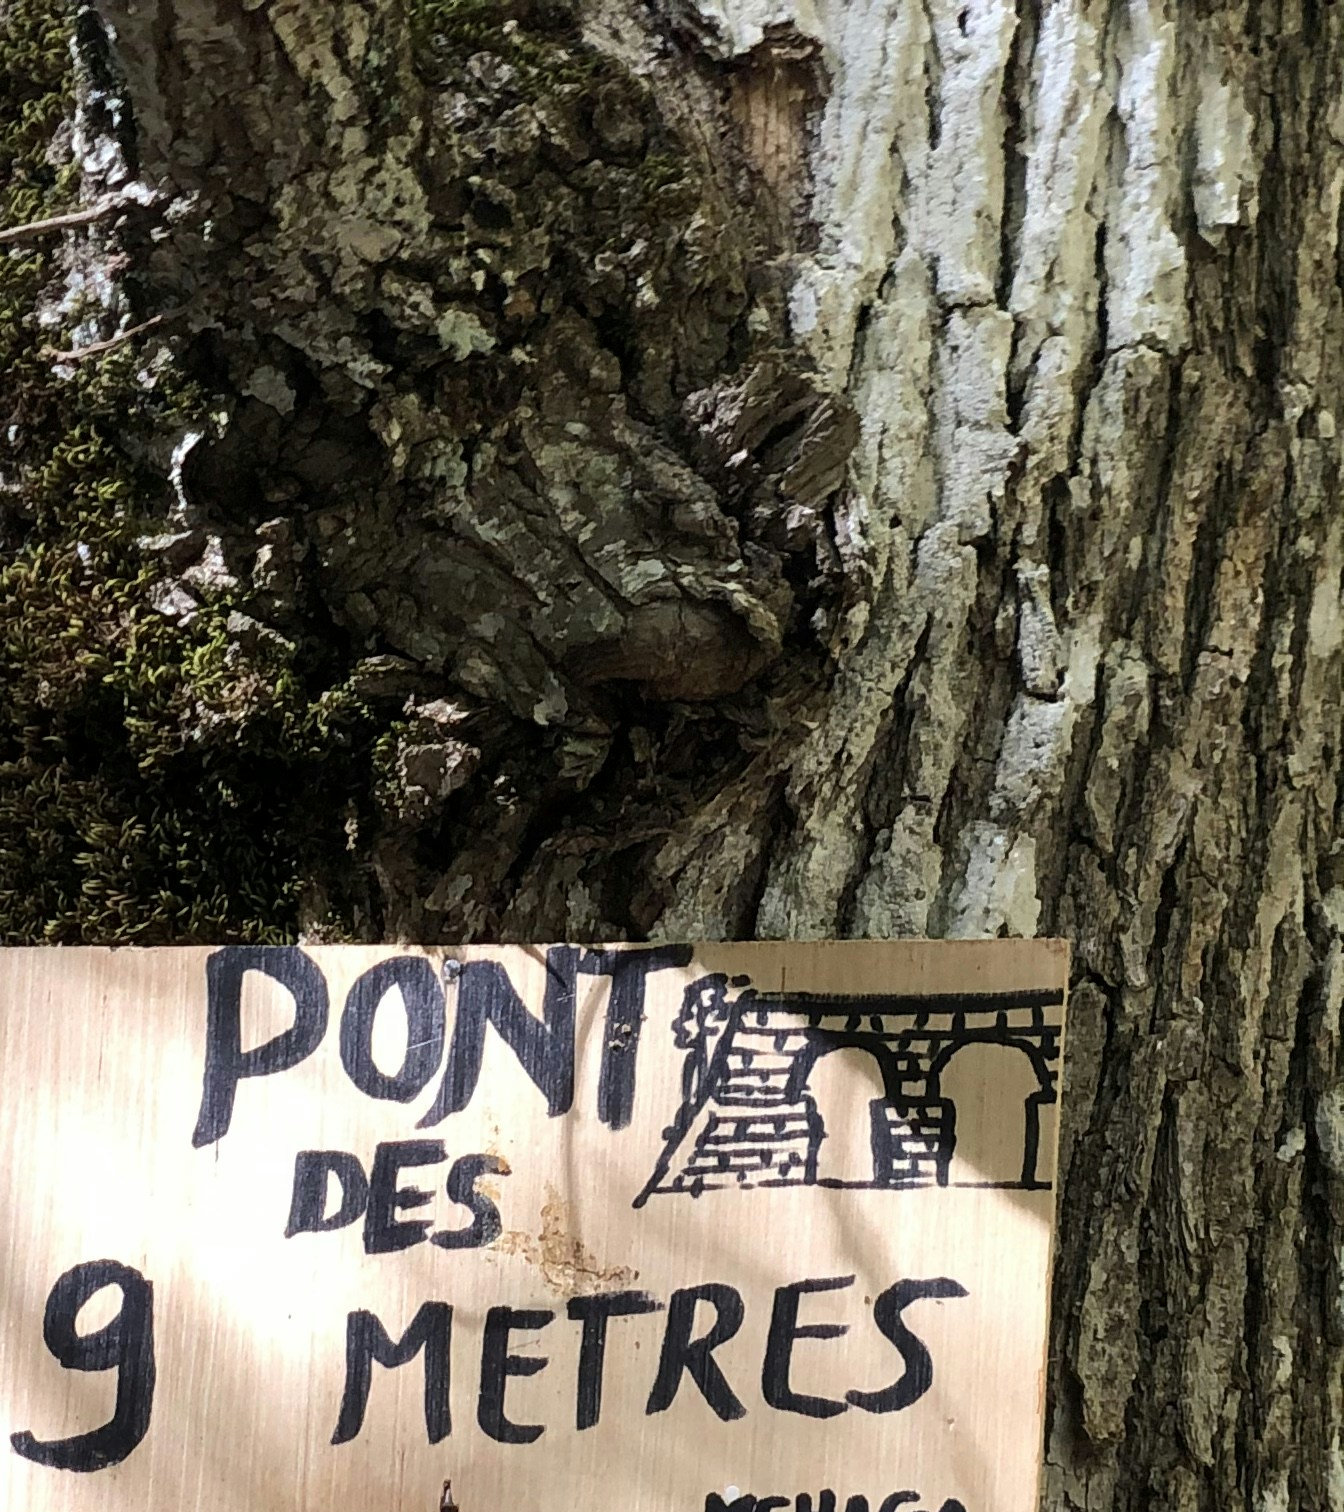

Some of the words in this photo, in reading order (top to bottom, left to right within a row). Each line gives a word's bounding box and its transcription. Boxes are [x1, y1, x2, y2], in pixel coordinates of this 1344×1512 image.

[192, 944, 694, 1149] PONT
[285, 1140, 511, 1254] DES
[10, 1258, 154, 1472] 9
[332, 1276, 969, 1445] METRES
